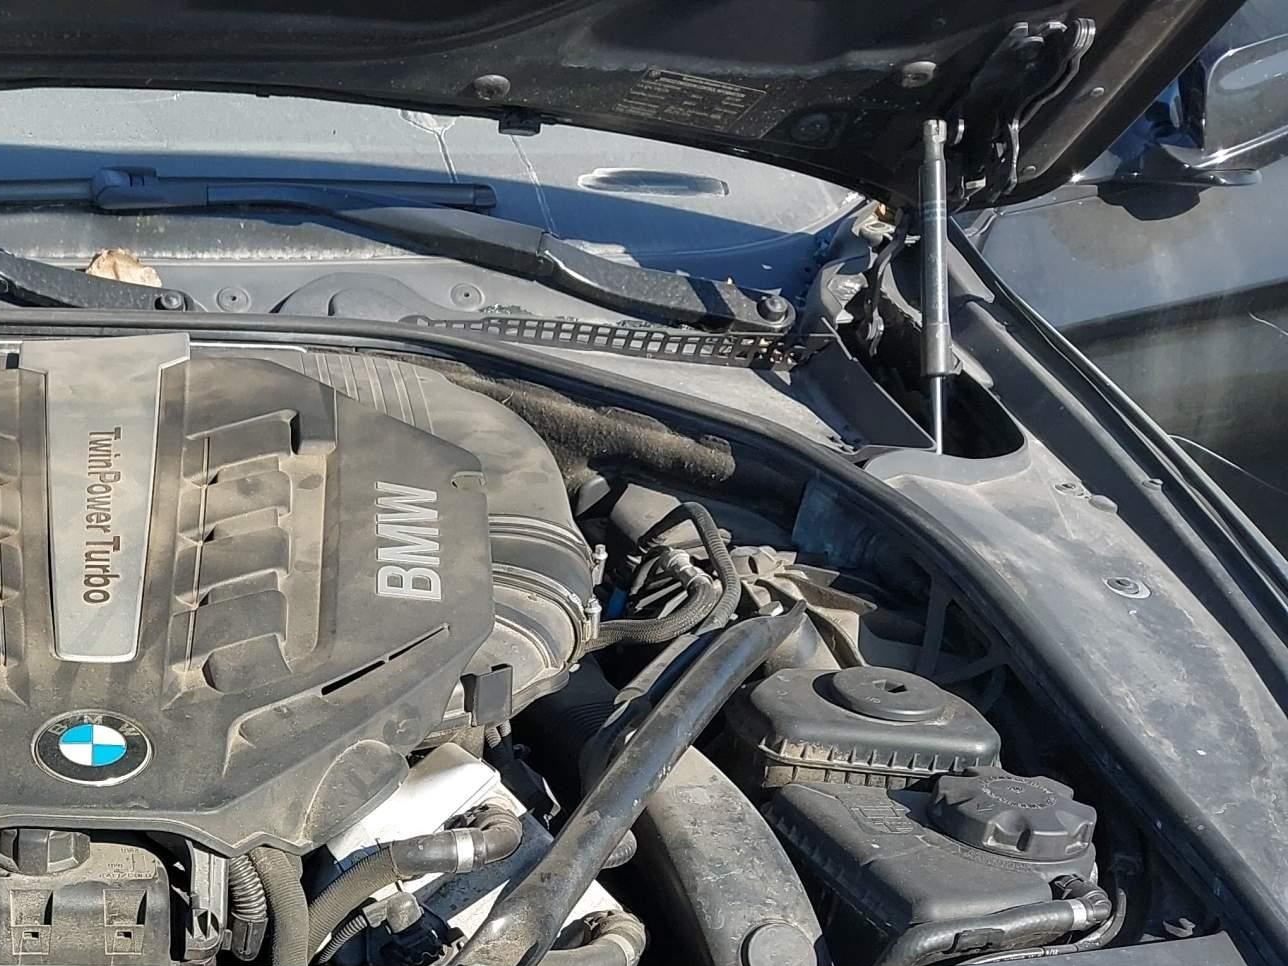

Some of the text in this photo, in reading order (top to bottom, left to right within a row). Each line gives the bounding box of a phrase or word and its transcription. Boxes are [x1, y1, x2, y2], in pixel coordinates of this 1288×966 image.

[83, 427, 121, 604] TwinPower Turbo
[376, 481, 442, 600] BMW
[48, 715, 140, 736] BMW
